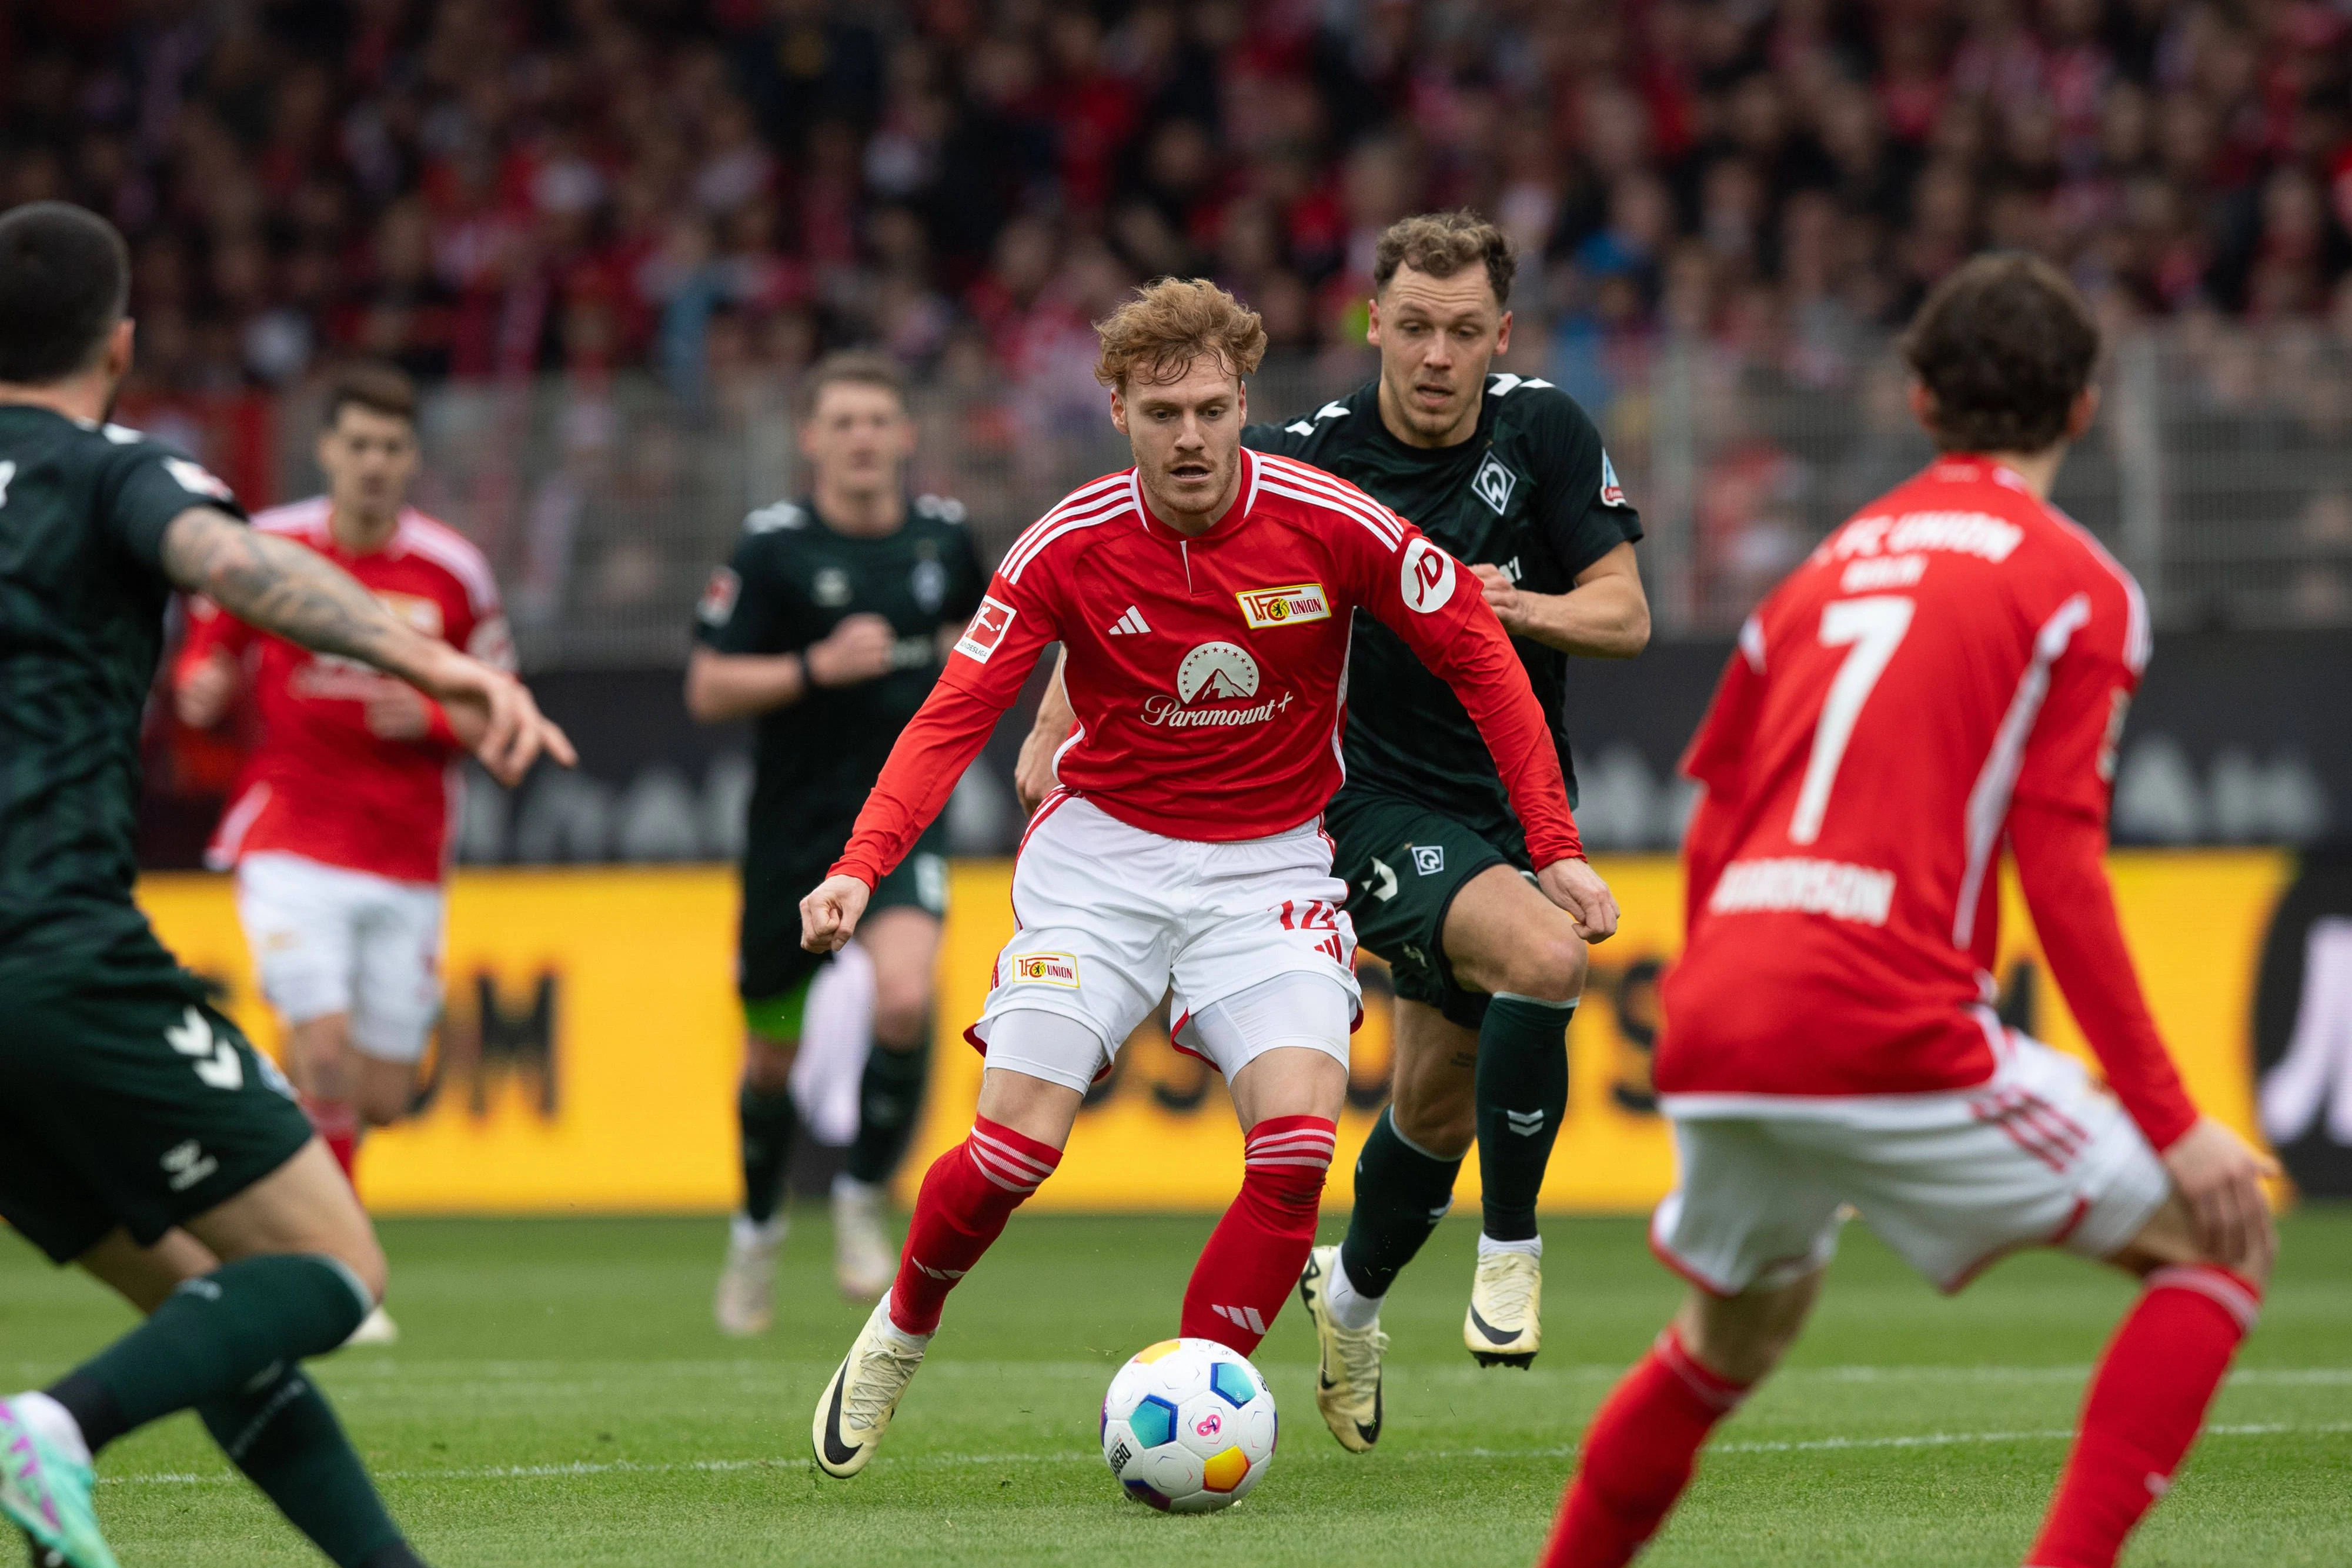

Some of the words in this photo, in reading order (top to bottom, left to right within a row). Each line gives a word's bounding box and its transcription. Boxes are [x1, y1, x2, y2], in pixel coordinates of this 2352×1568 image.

[1414, 547, 1444, 607] JD
[1289, 598, 1322, 616] UNION
[1788, 594, 1916, 845] 7
[1047, 965, 1073, 979] UNION
